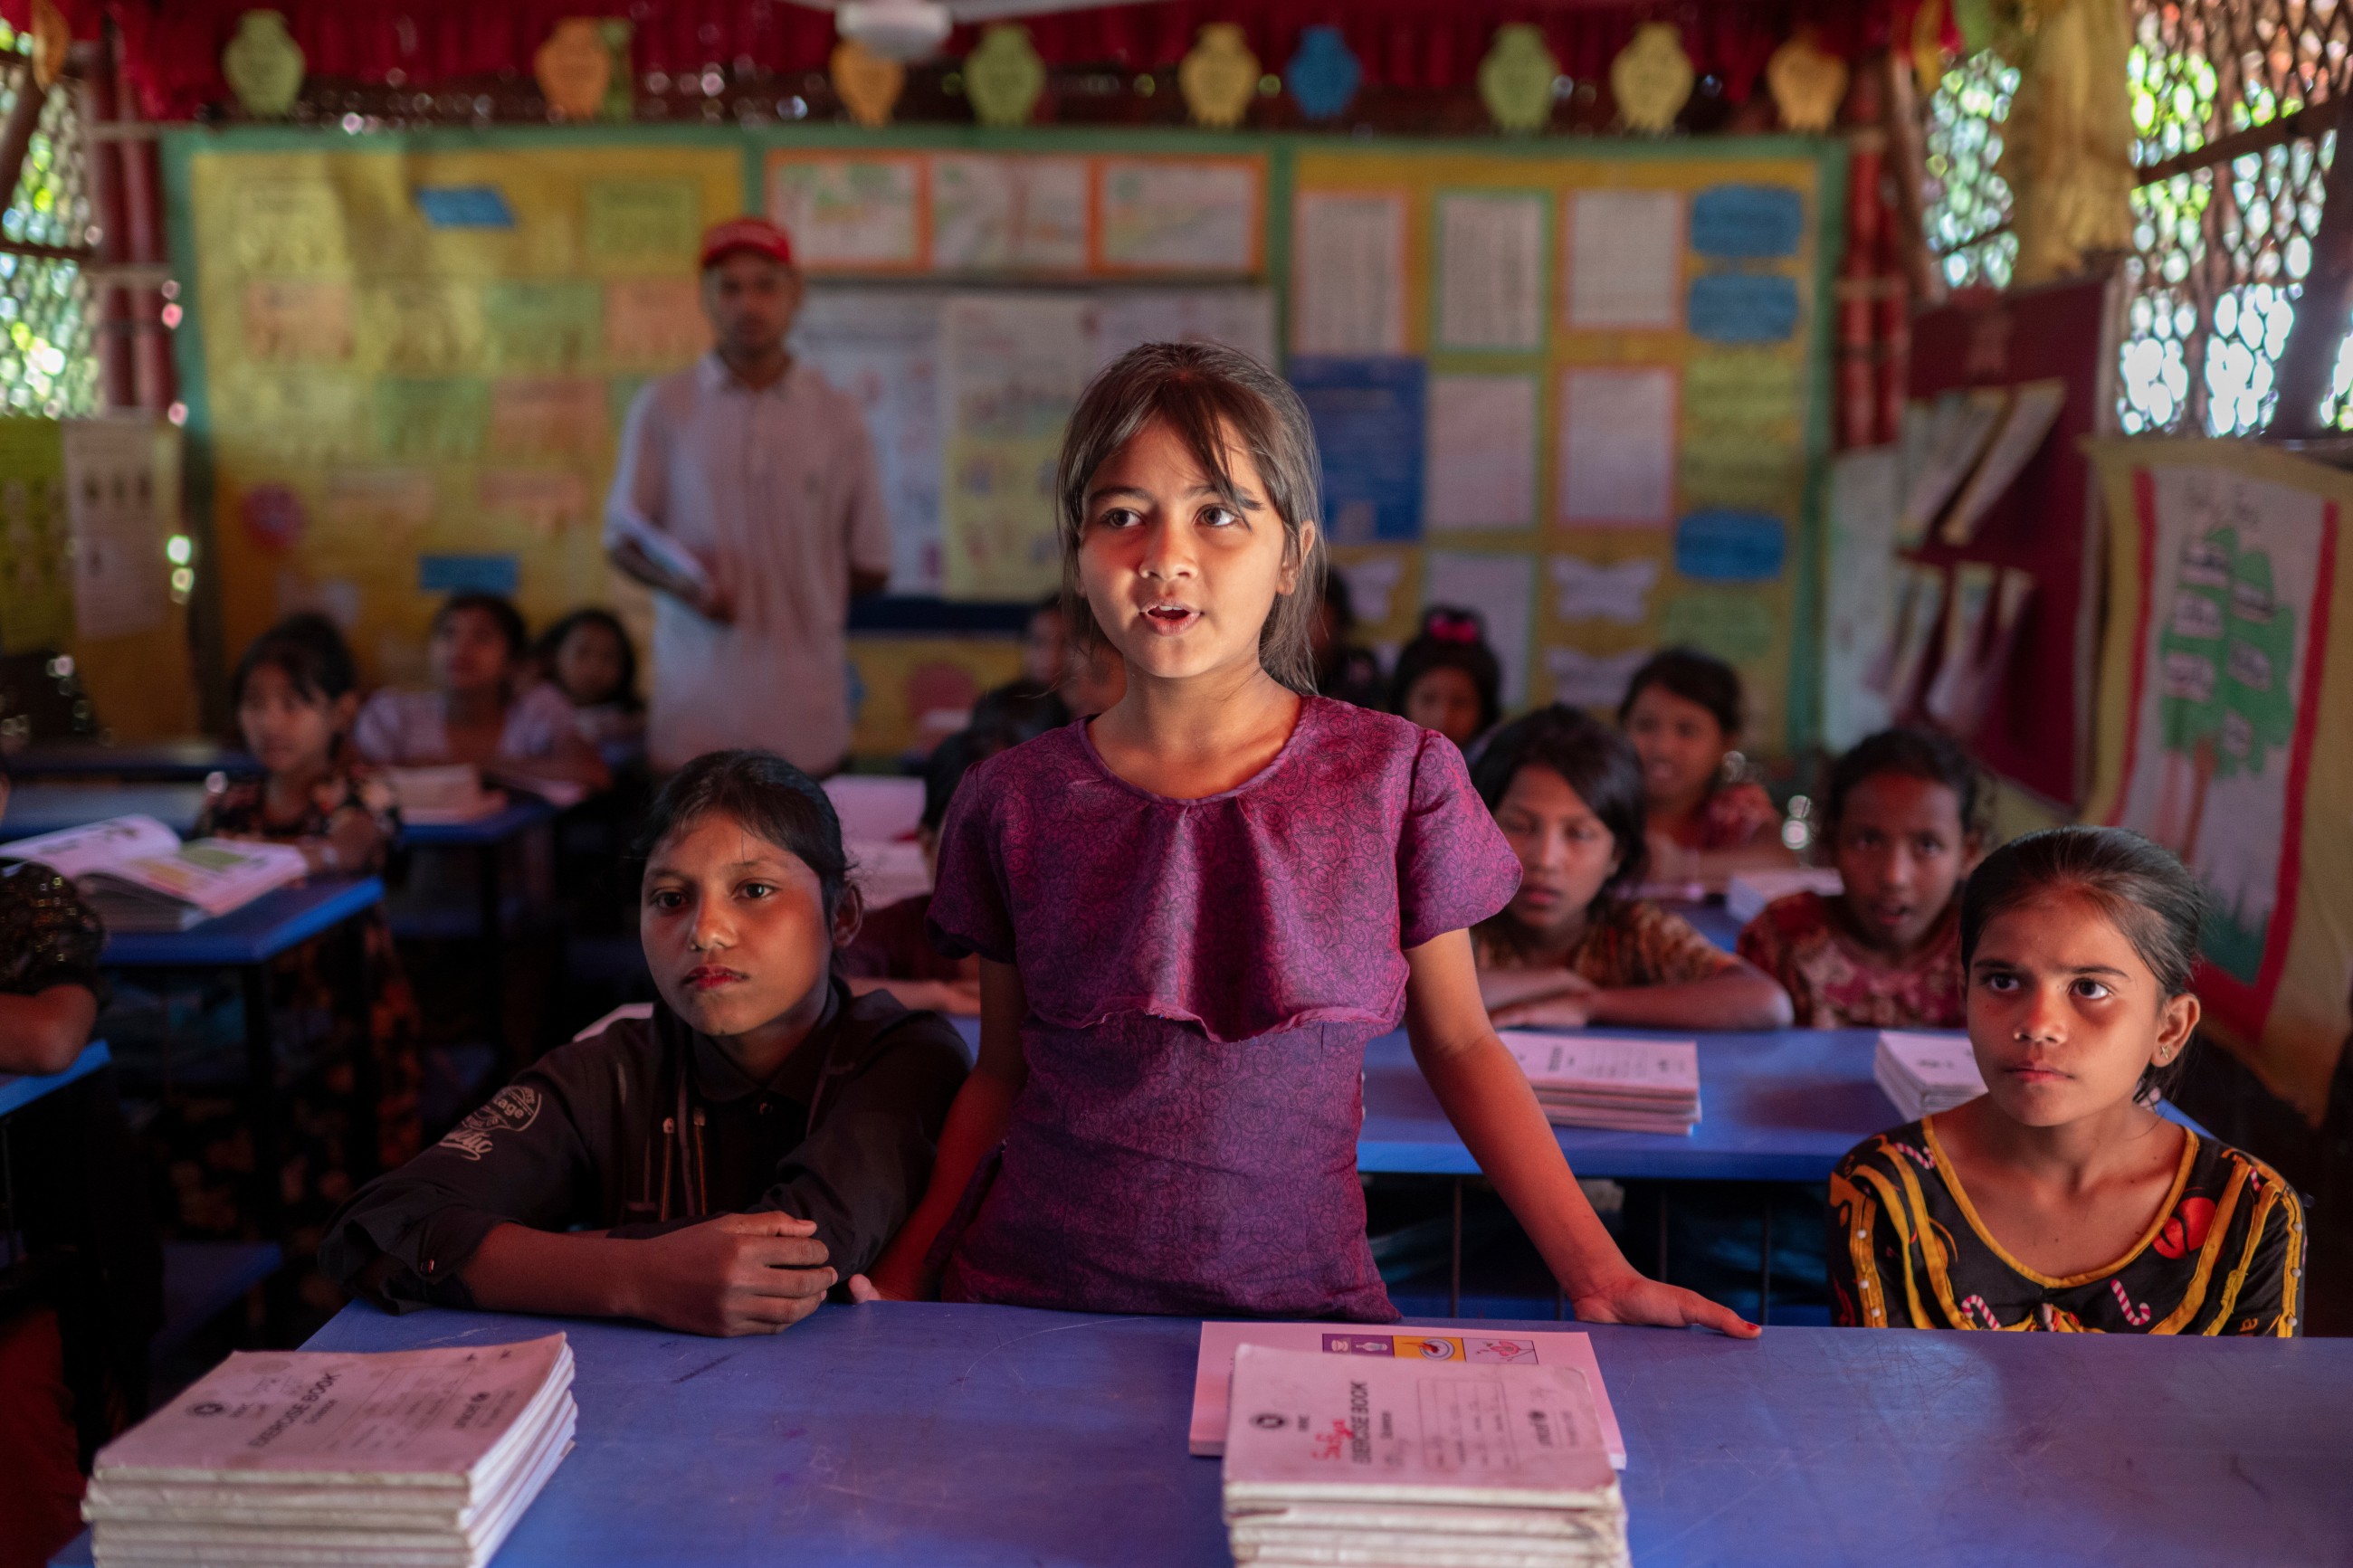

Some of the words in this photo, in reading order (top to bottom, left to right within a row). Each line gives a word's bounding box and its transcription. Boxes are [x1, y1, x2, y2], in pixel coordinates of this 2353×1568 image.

[247, 1403, 310, 1448] EXERCISE
[301, 1372, 341, 1402] BOOK
[1350, 1380, 1369, 1413] BOOK
